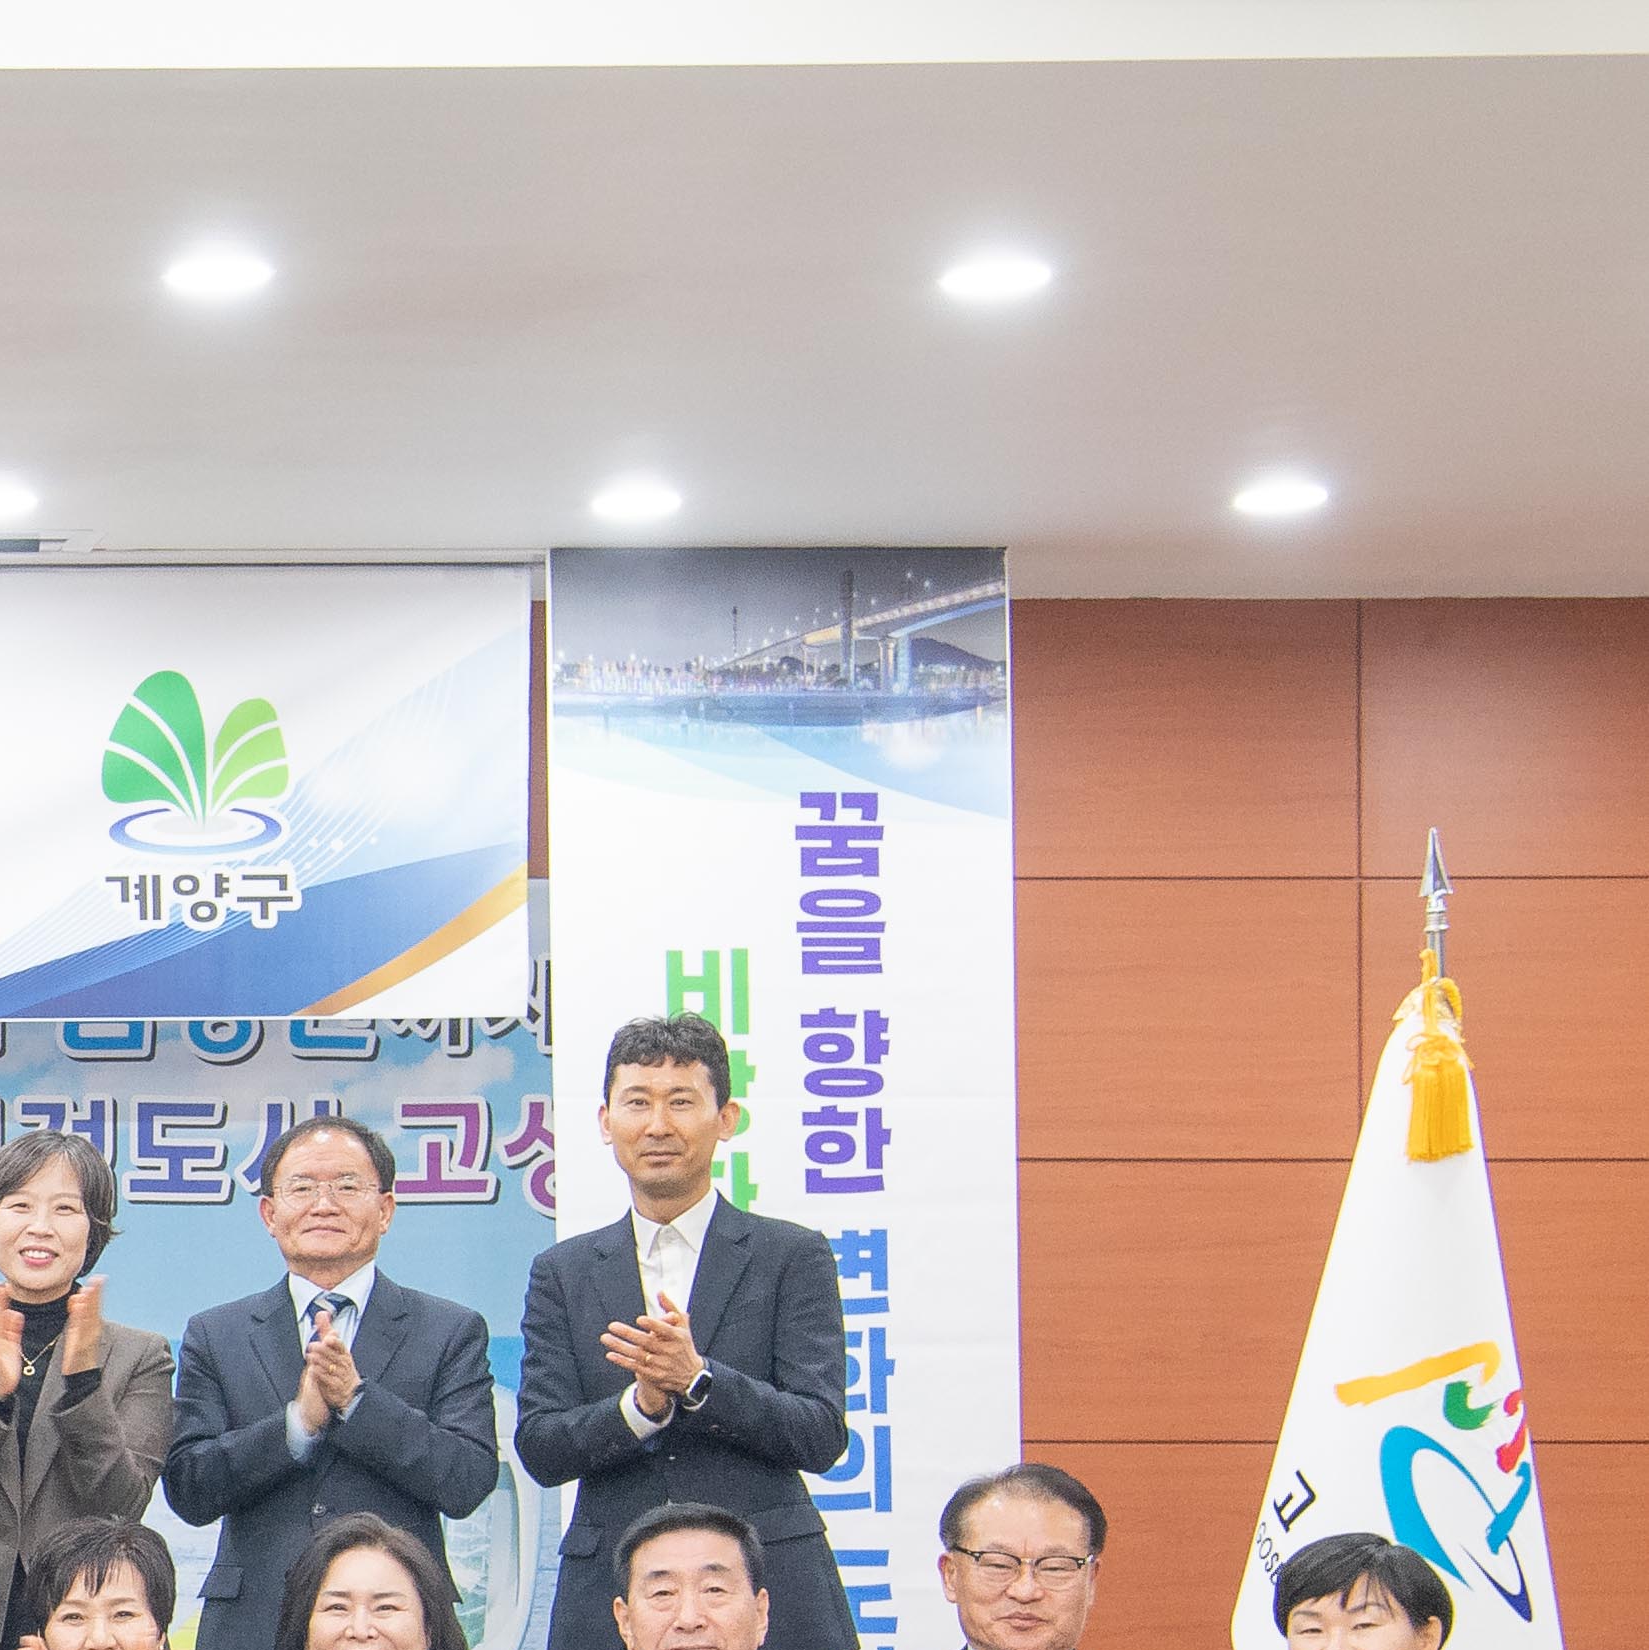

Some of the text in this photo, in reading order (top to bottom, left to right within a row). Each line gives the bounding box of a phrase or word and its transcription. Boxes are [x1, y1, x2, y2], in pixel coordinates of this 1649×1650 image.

[105, 874, 293, 922] 계양구
[796, 792, 885, 974] 꿈을
[801, 1008, 891, 1193] 향한
